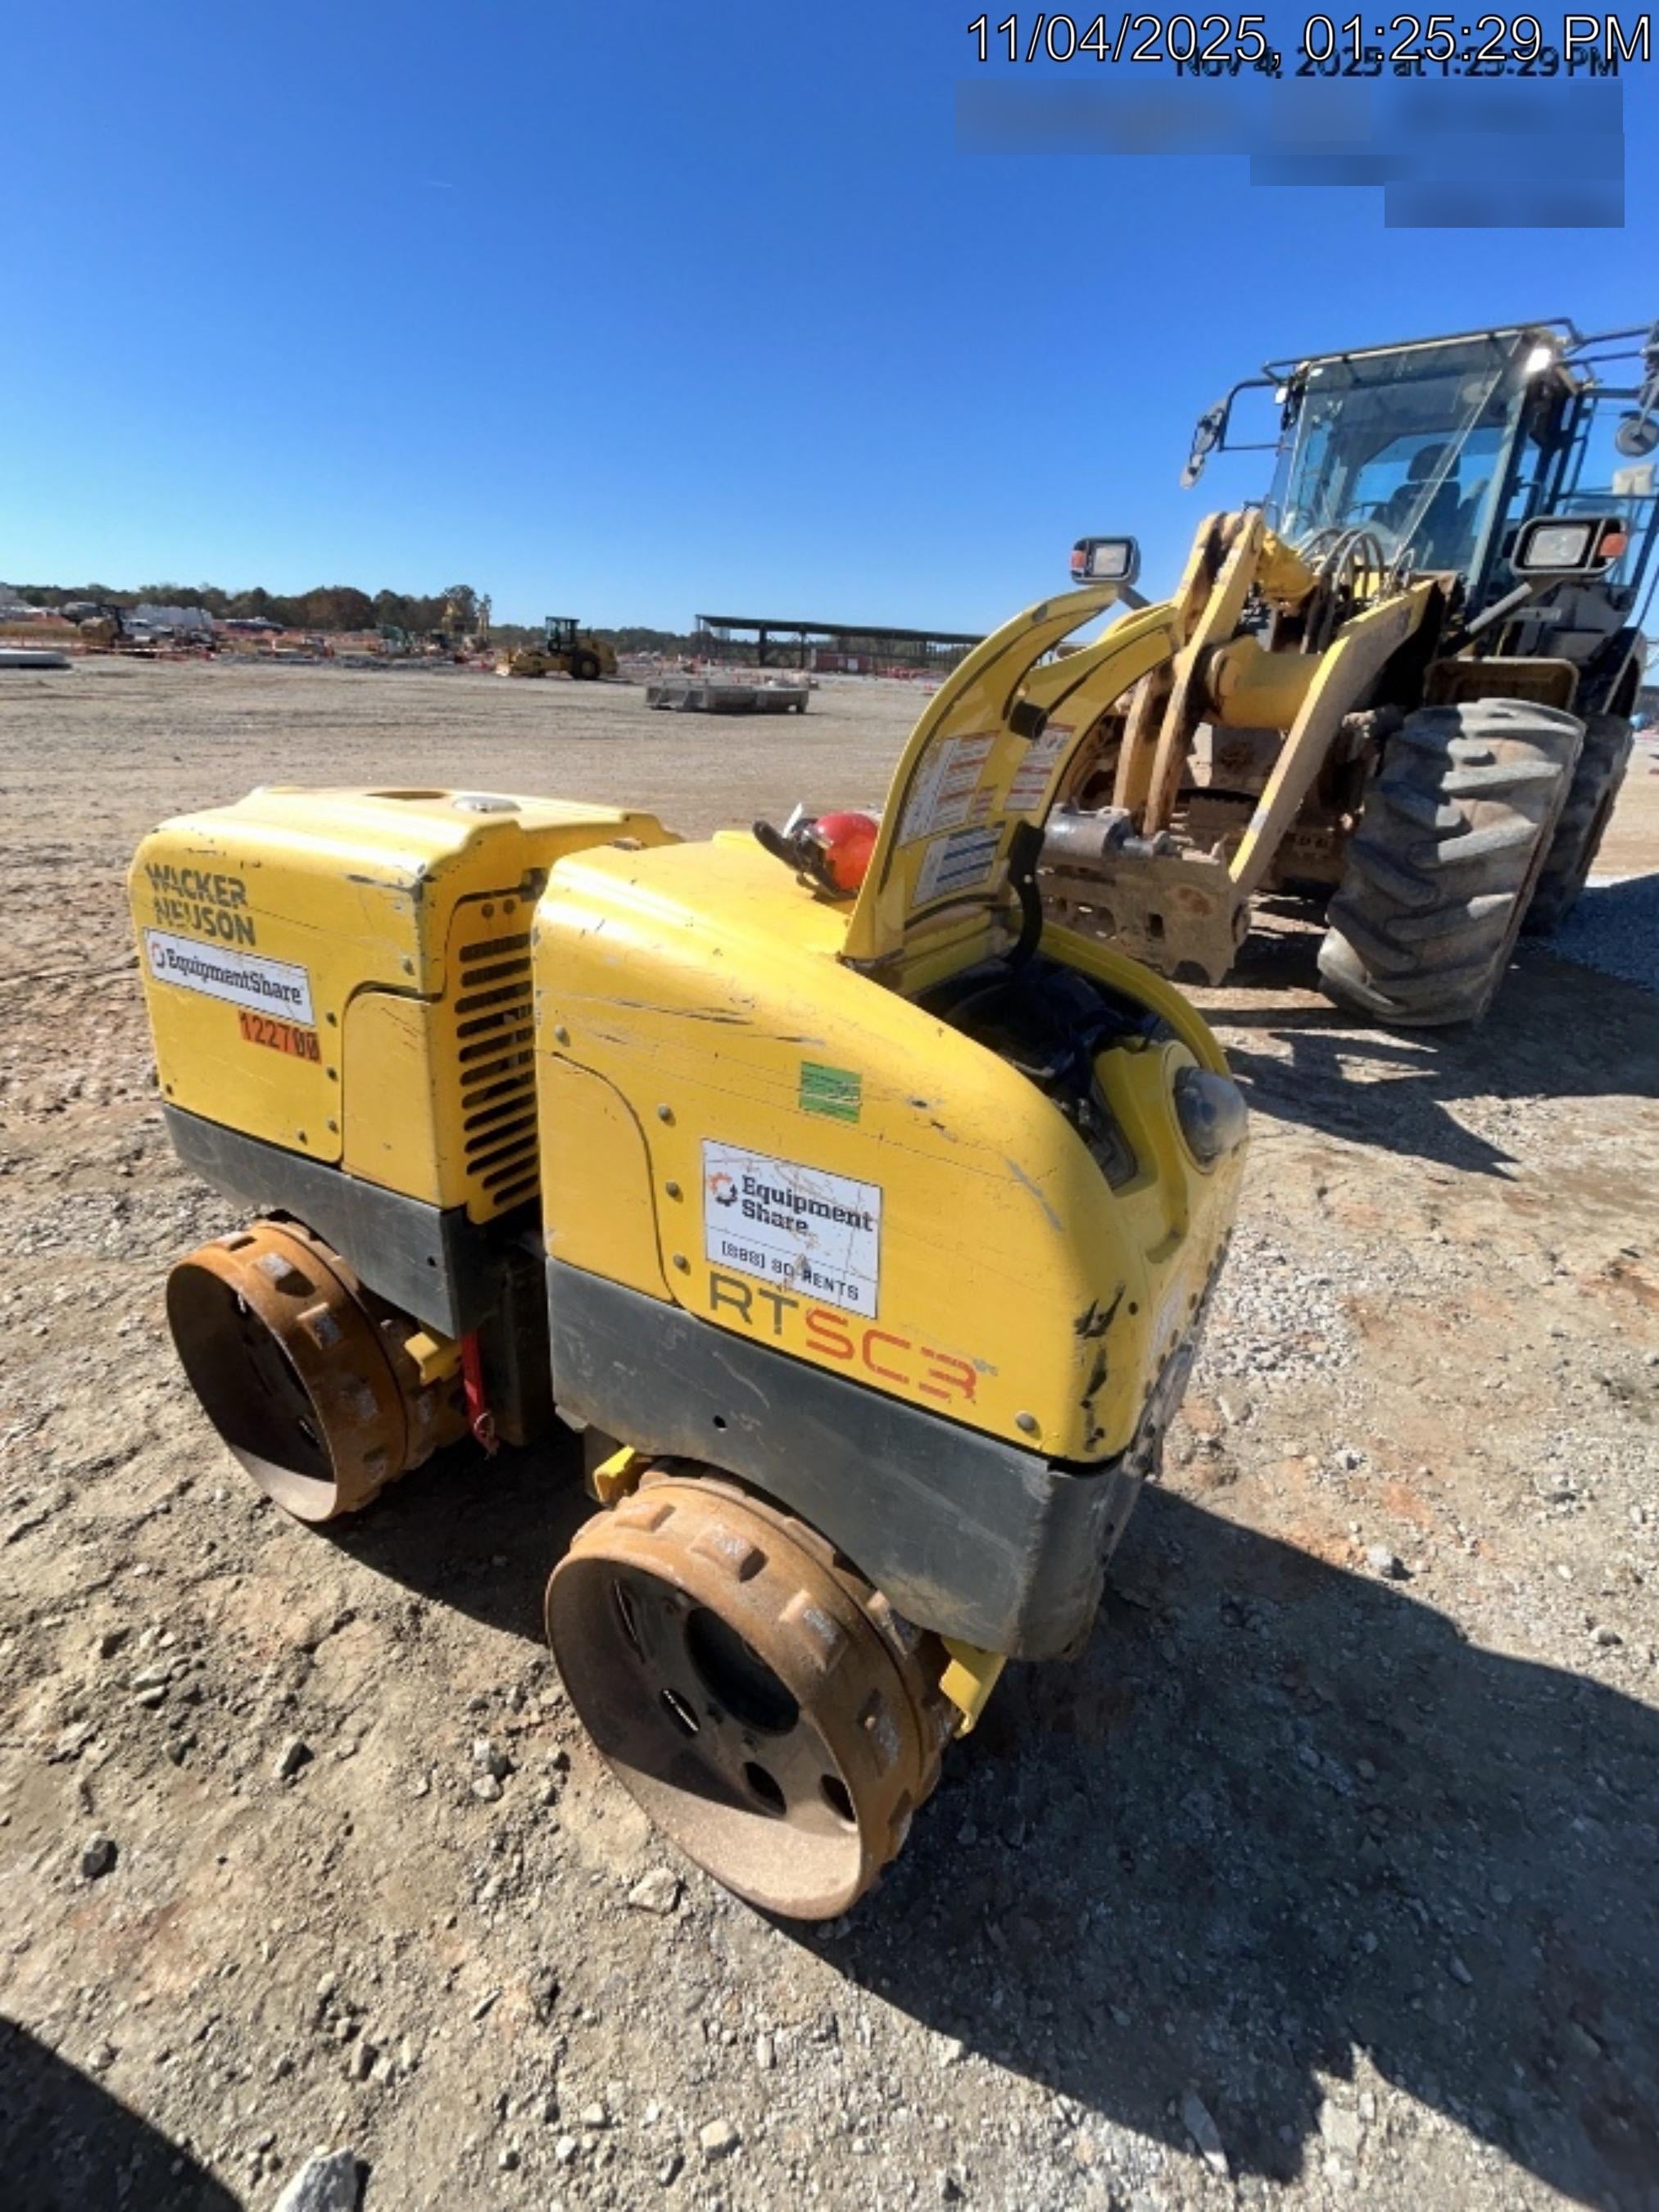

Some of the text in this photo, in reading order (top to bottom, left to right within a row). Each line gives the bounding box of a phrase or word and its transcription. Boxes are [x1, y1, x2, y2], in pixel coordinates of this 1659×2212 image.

[145, 863, 248, 909] WACKER
[153, 897, 256, 947] NEUSON
[166, 948, 302, 1005] EquipmentShare
[741, 1174, 873, 1231] Equipment
[741, 1199, 809, 1235] Share
